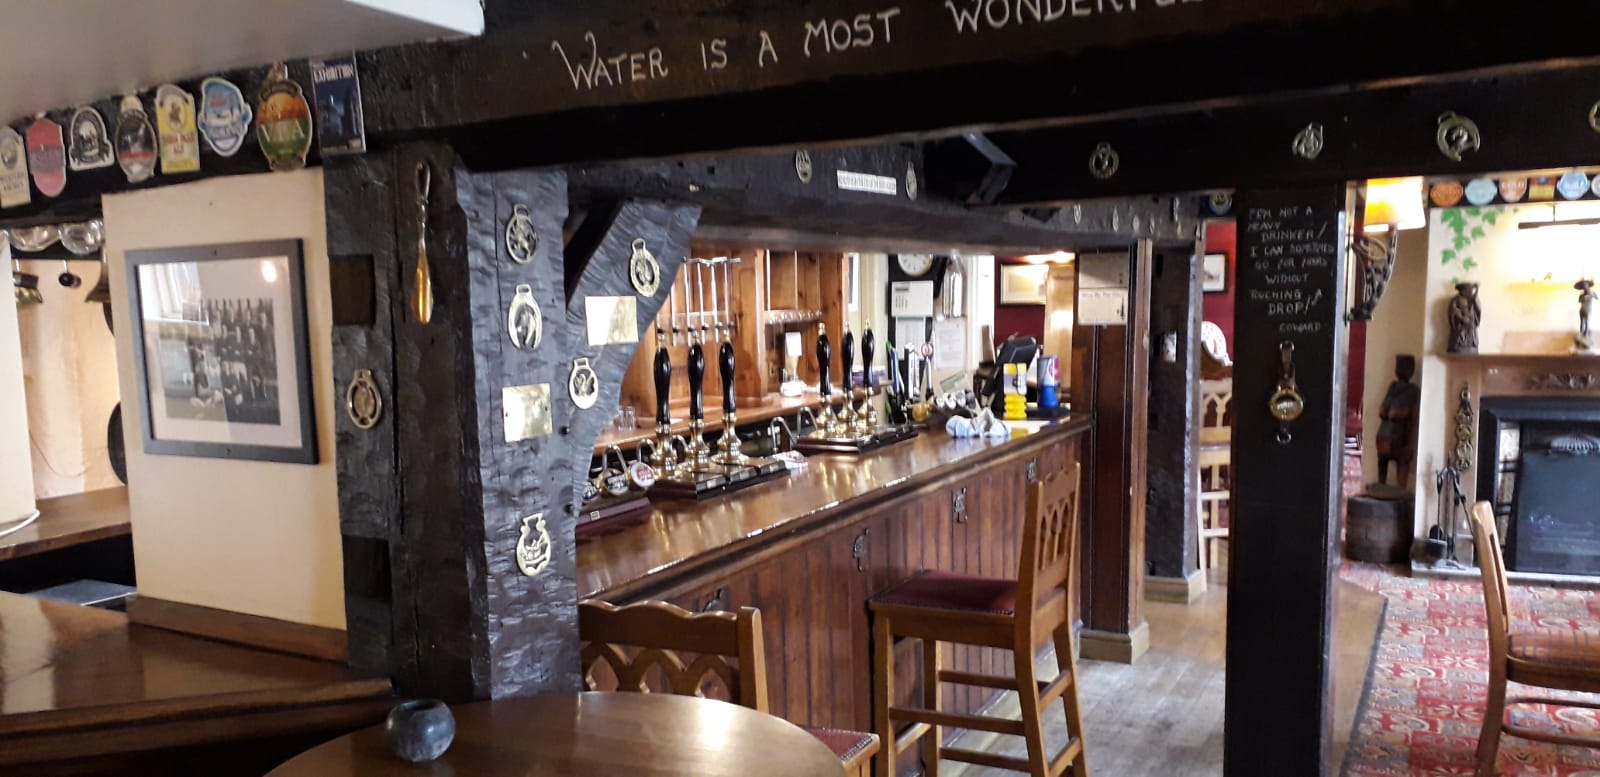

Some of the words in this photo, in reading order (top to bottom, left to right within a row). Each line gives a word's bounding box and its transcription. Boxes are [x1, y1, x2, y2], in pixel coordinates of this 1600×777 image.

[552, 31, 669, 91] WATER
[700, 39, 728, 71] IS
[758, 30, 779, 68] A
[803, 8, 902, 57] MOST
